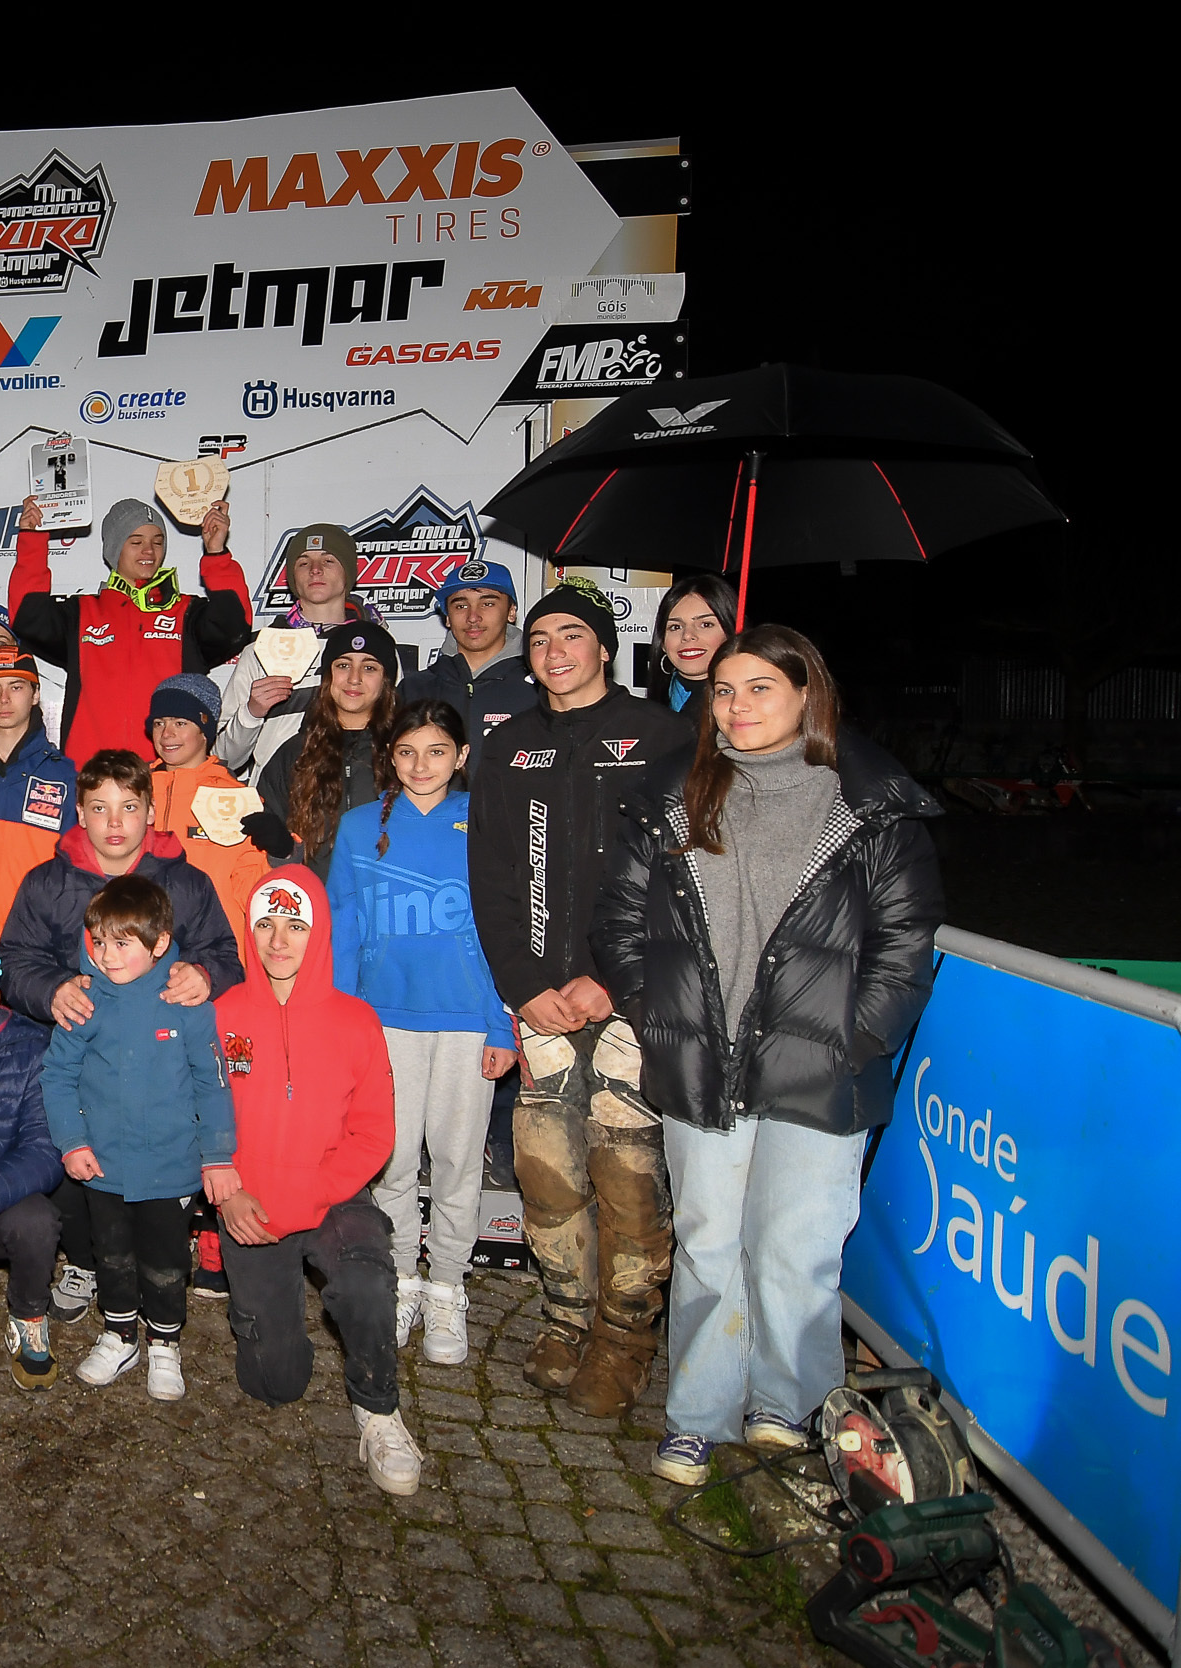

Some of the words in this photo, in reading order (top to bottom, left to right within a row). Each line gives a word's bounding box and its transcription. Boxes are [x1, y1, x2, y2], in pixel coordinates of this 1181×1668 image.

[194, 138, 526, 217] MAXXIS
[386, 207, 521, 245] TIRES
[9, 276, 40, 286] Husqvarna
[463, 280, 542, 312] KTM
[597, 300, 627, 313] Góis
[346, 340, 501, 367] GASGAS
[538, 338, 623, 382] FMP
[118, 388, 186, 408] create
[282, 386, 396, 417] Husqvarna
[118, 408, 166, 420] business
[633, 424, 717, 440] Valvoline
[184, 469, 200, 492] 1
[279, 636, 296, 656] 3
[218, 796, 236, 816] 3
